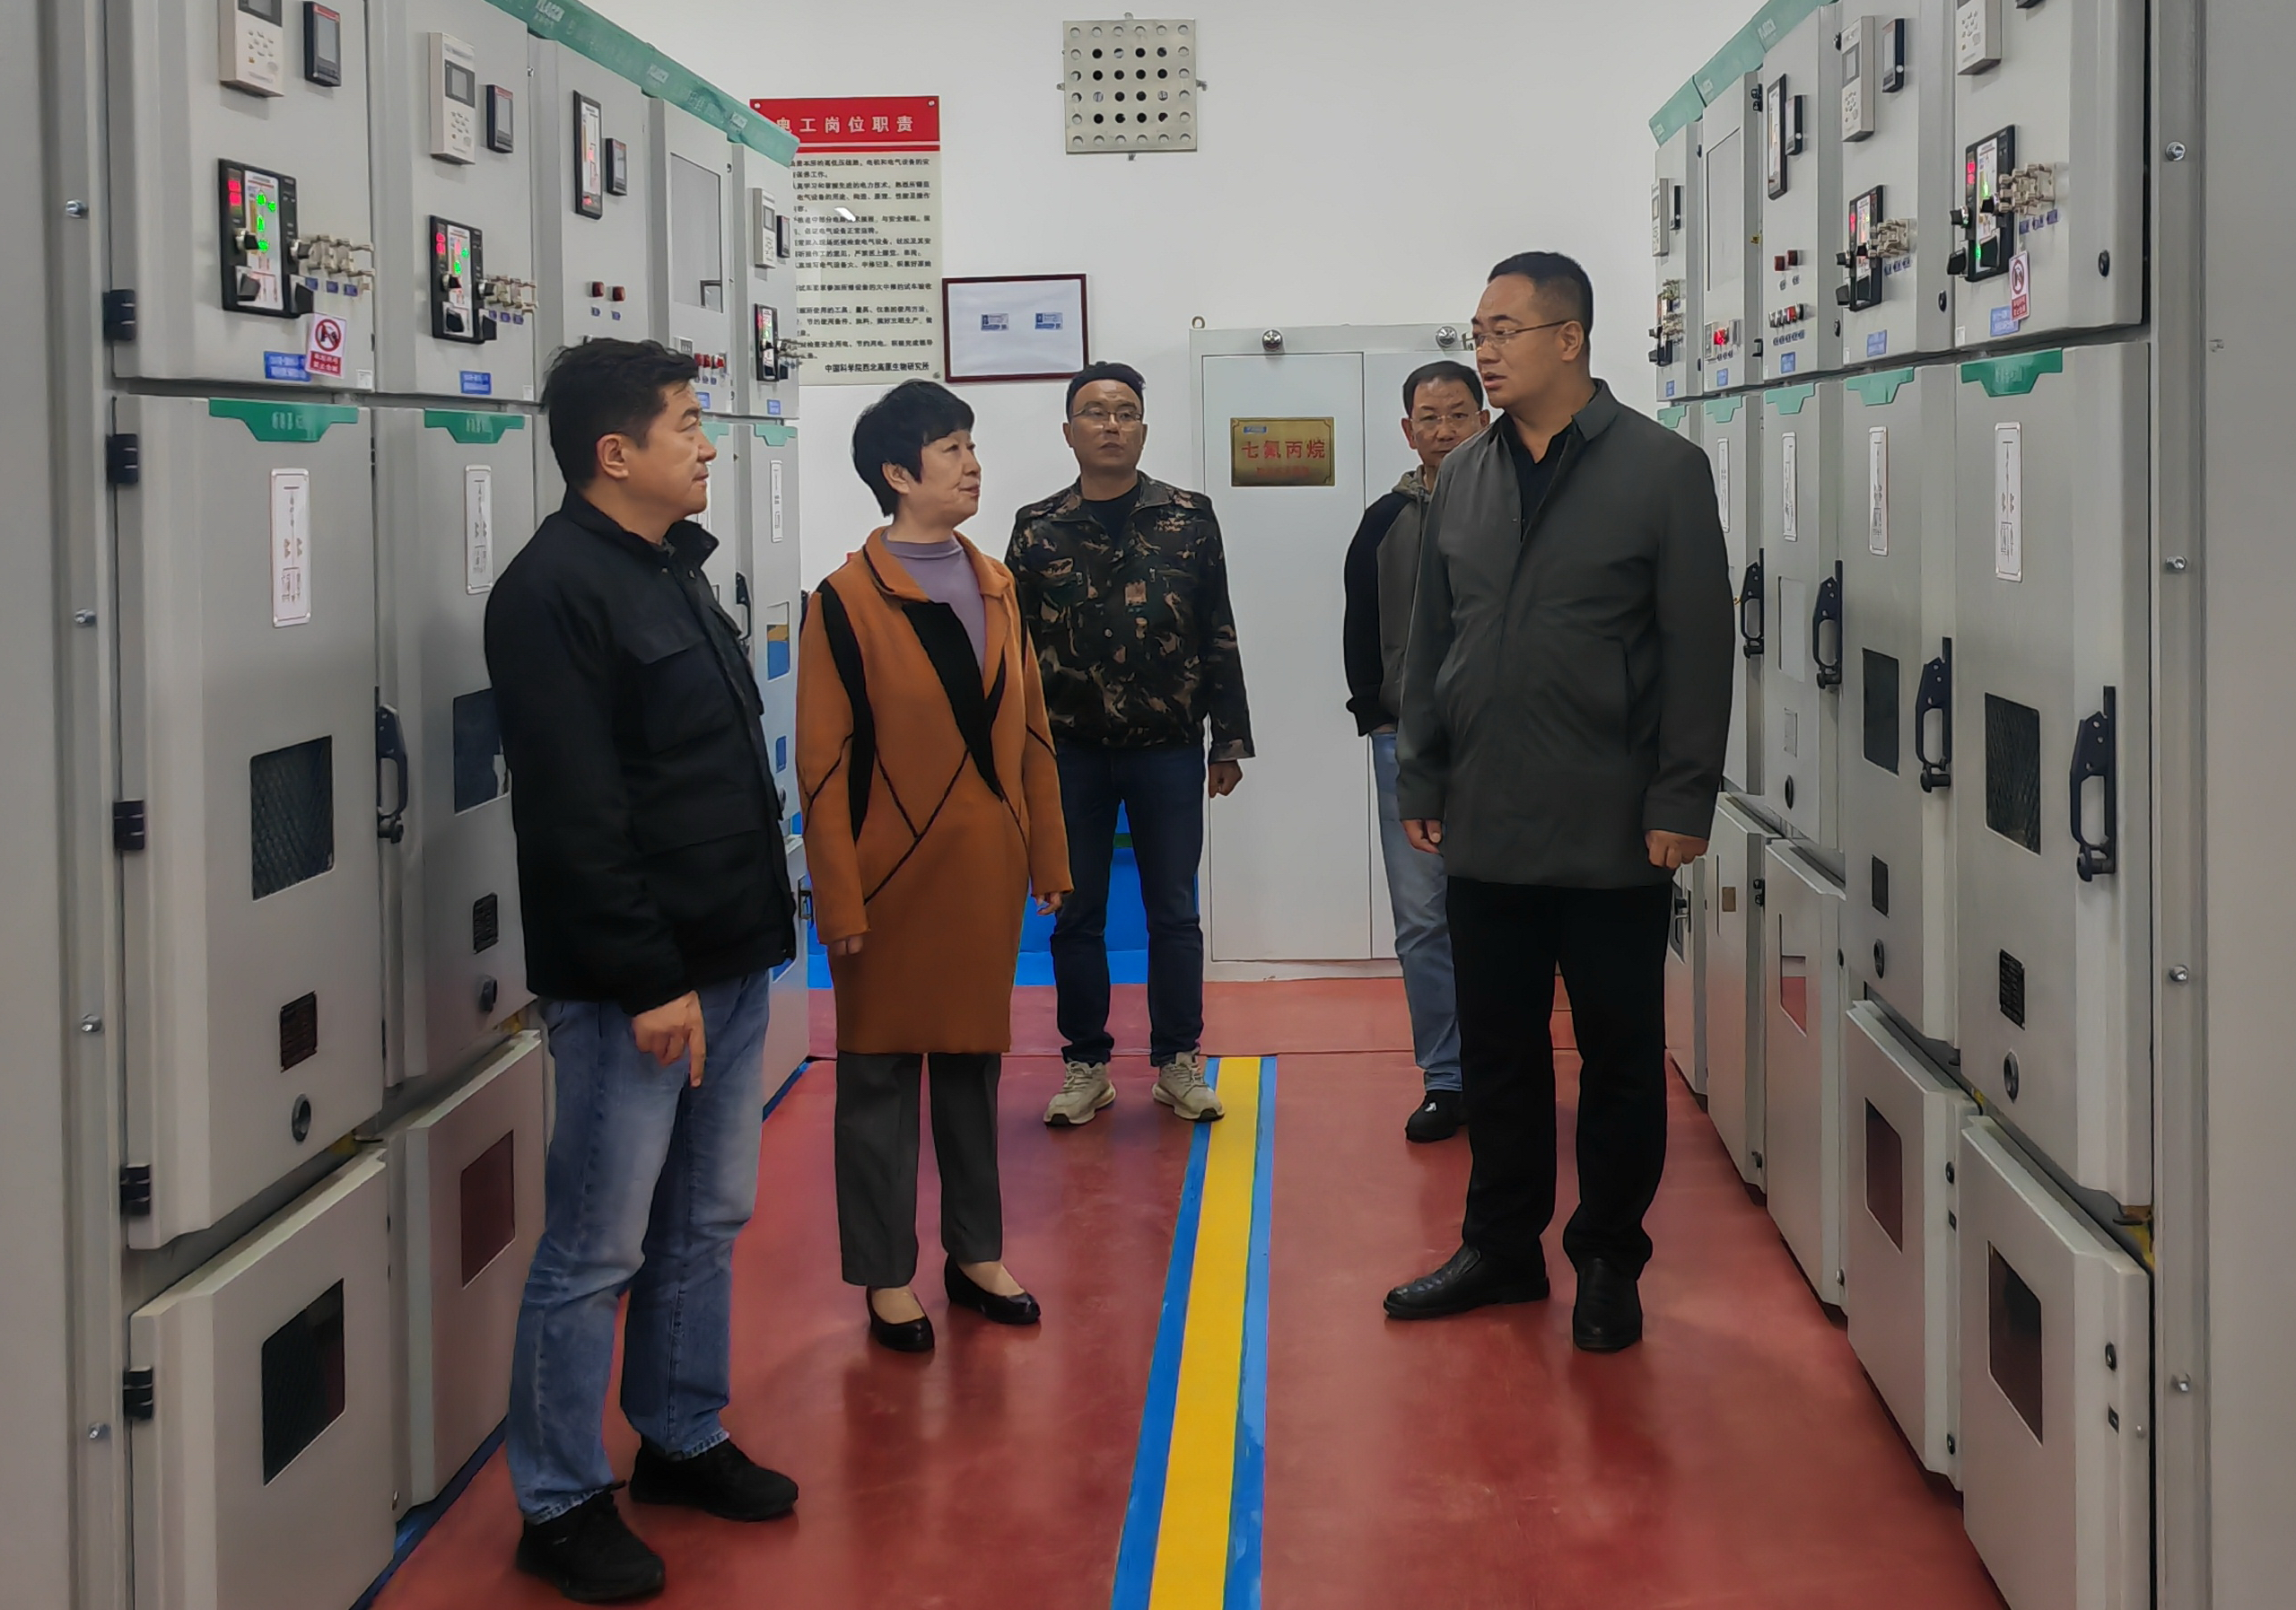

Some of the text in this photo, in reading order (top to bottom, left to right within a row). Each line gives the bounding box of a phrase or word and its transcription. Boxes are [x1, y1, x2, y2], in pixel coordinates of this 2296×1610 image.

[825, 361, 930, 373] 中国科学院西北高原生物研究所
